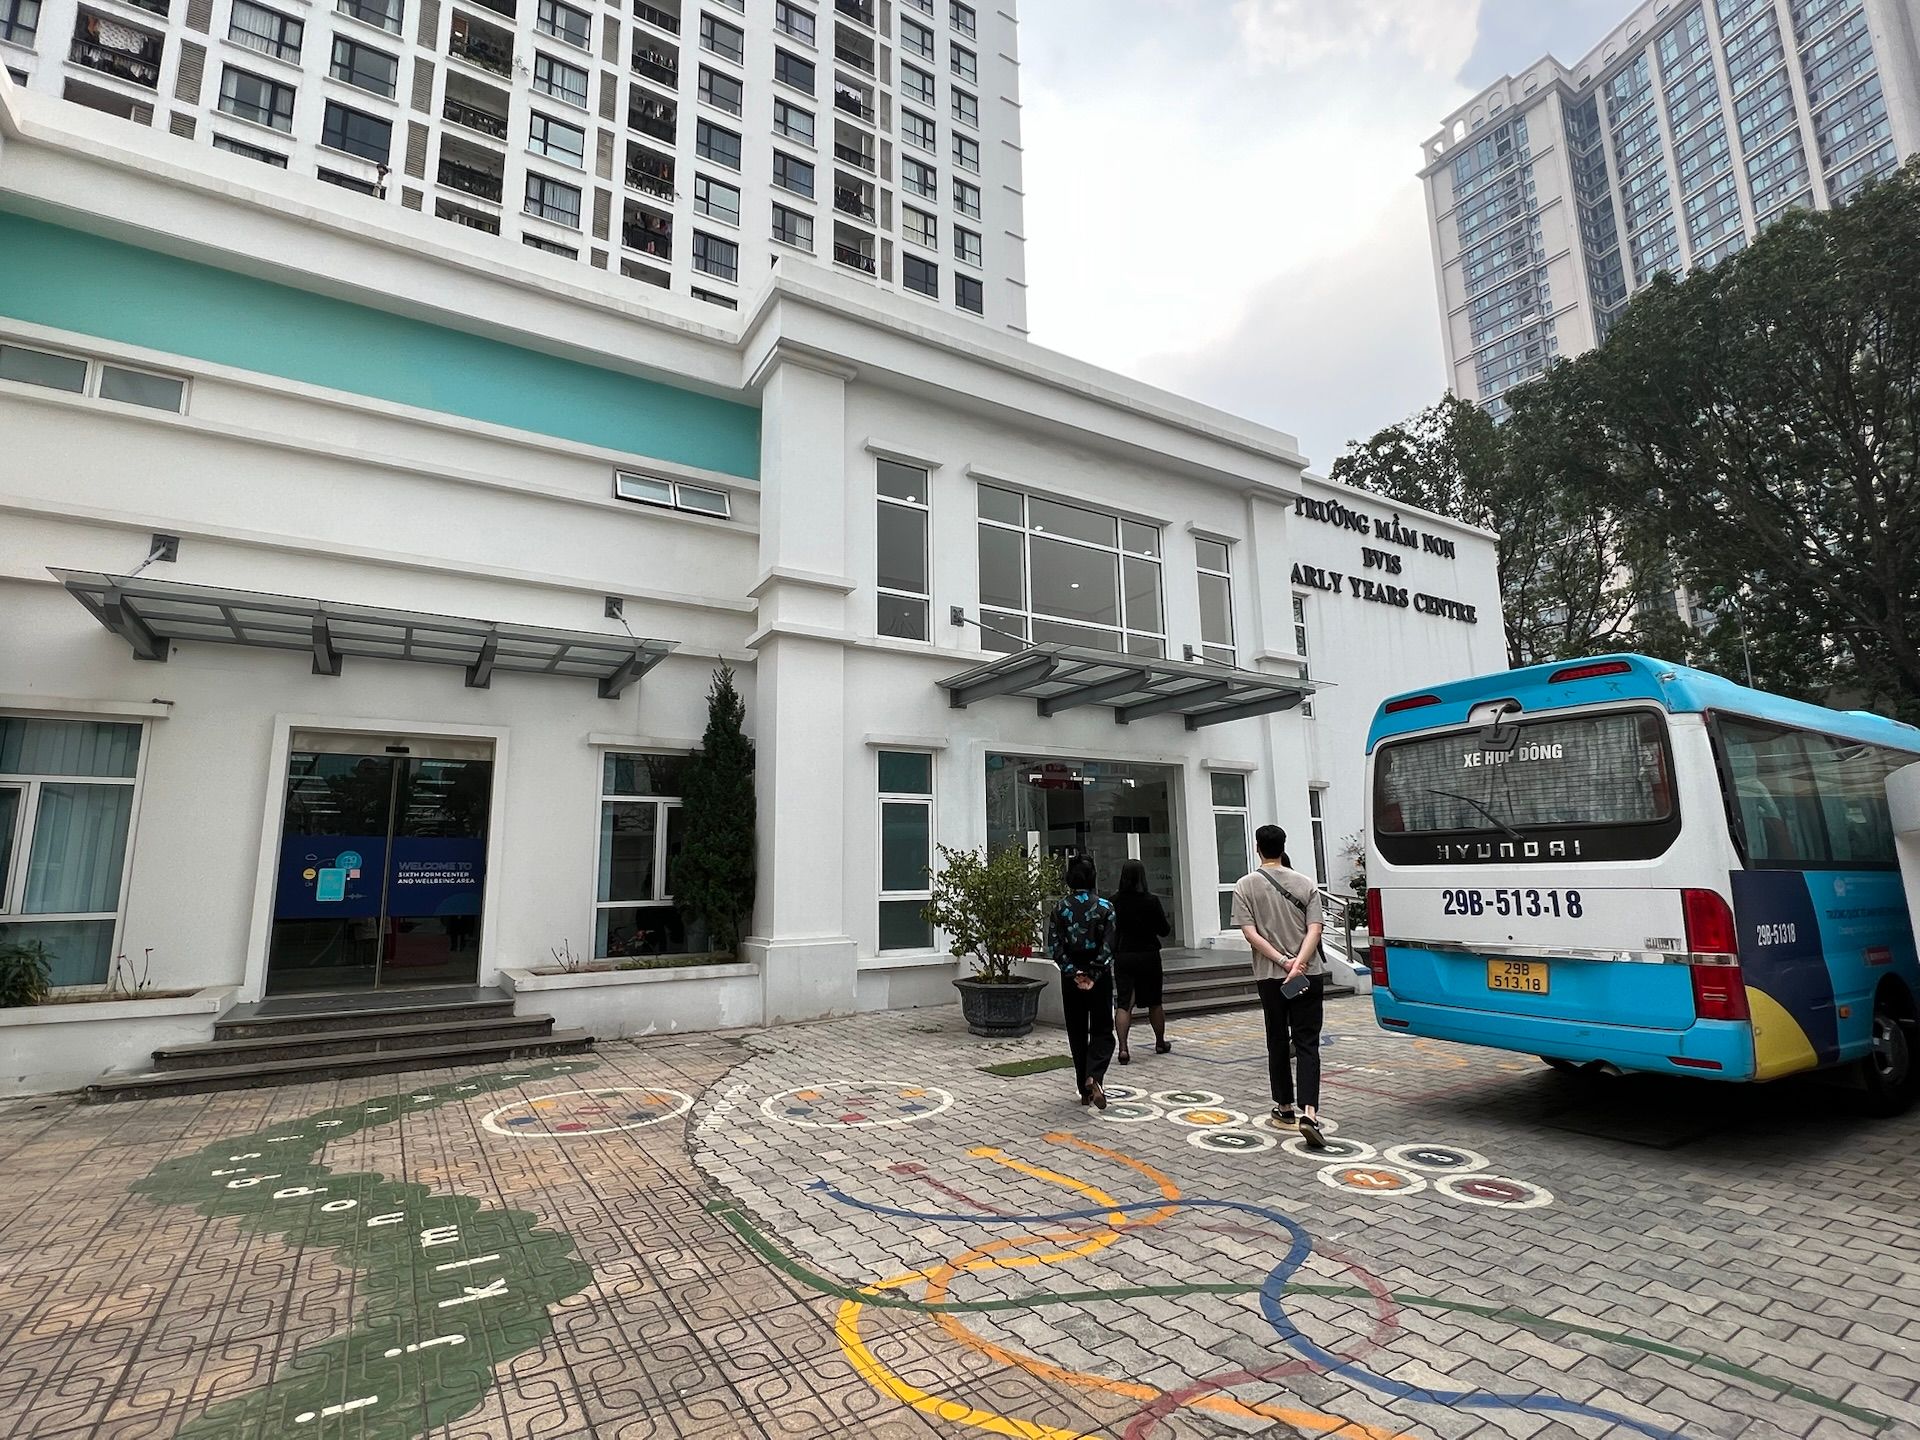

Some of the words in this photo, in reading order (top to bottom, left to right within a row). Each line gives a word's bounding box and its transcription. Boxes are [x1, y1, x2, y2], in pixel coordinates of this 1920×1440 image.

[1421, 533, 1456, 559] NON
[1361, 547, 1403, 575] BVIS
[1291, 562, 1343, 593] ARLY
[1348, 576, 1409, 608] YEARS
[1413, 592, 1478, 624] CENTRE
[1463, 752, 1481, 768] XE
[1519, 741, 1563, 762] ĐỒNG
[1436, 840, 1581, 859] HYUNDAI
[398, 861, 456, 871] WELCOME
[458, 862, 472, 871] TO
[1442, 889, 1583, 918] 29B-513.18
[1756, 923, 1796, 946] 29B-51318
[1504, 962, 1530, 976] 29B
[1494, 976, 1541, 991] 513.18
[1216, 1135, 1246, 1146] 5
[1418, 1152, 1454, 1163] 3
[1352, 1173, 1391, 1186] 2
[1474, 1184, 1513, 1196] 1
